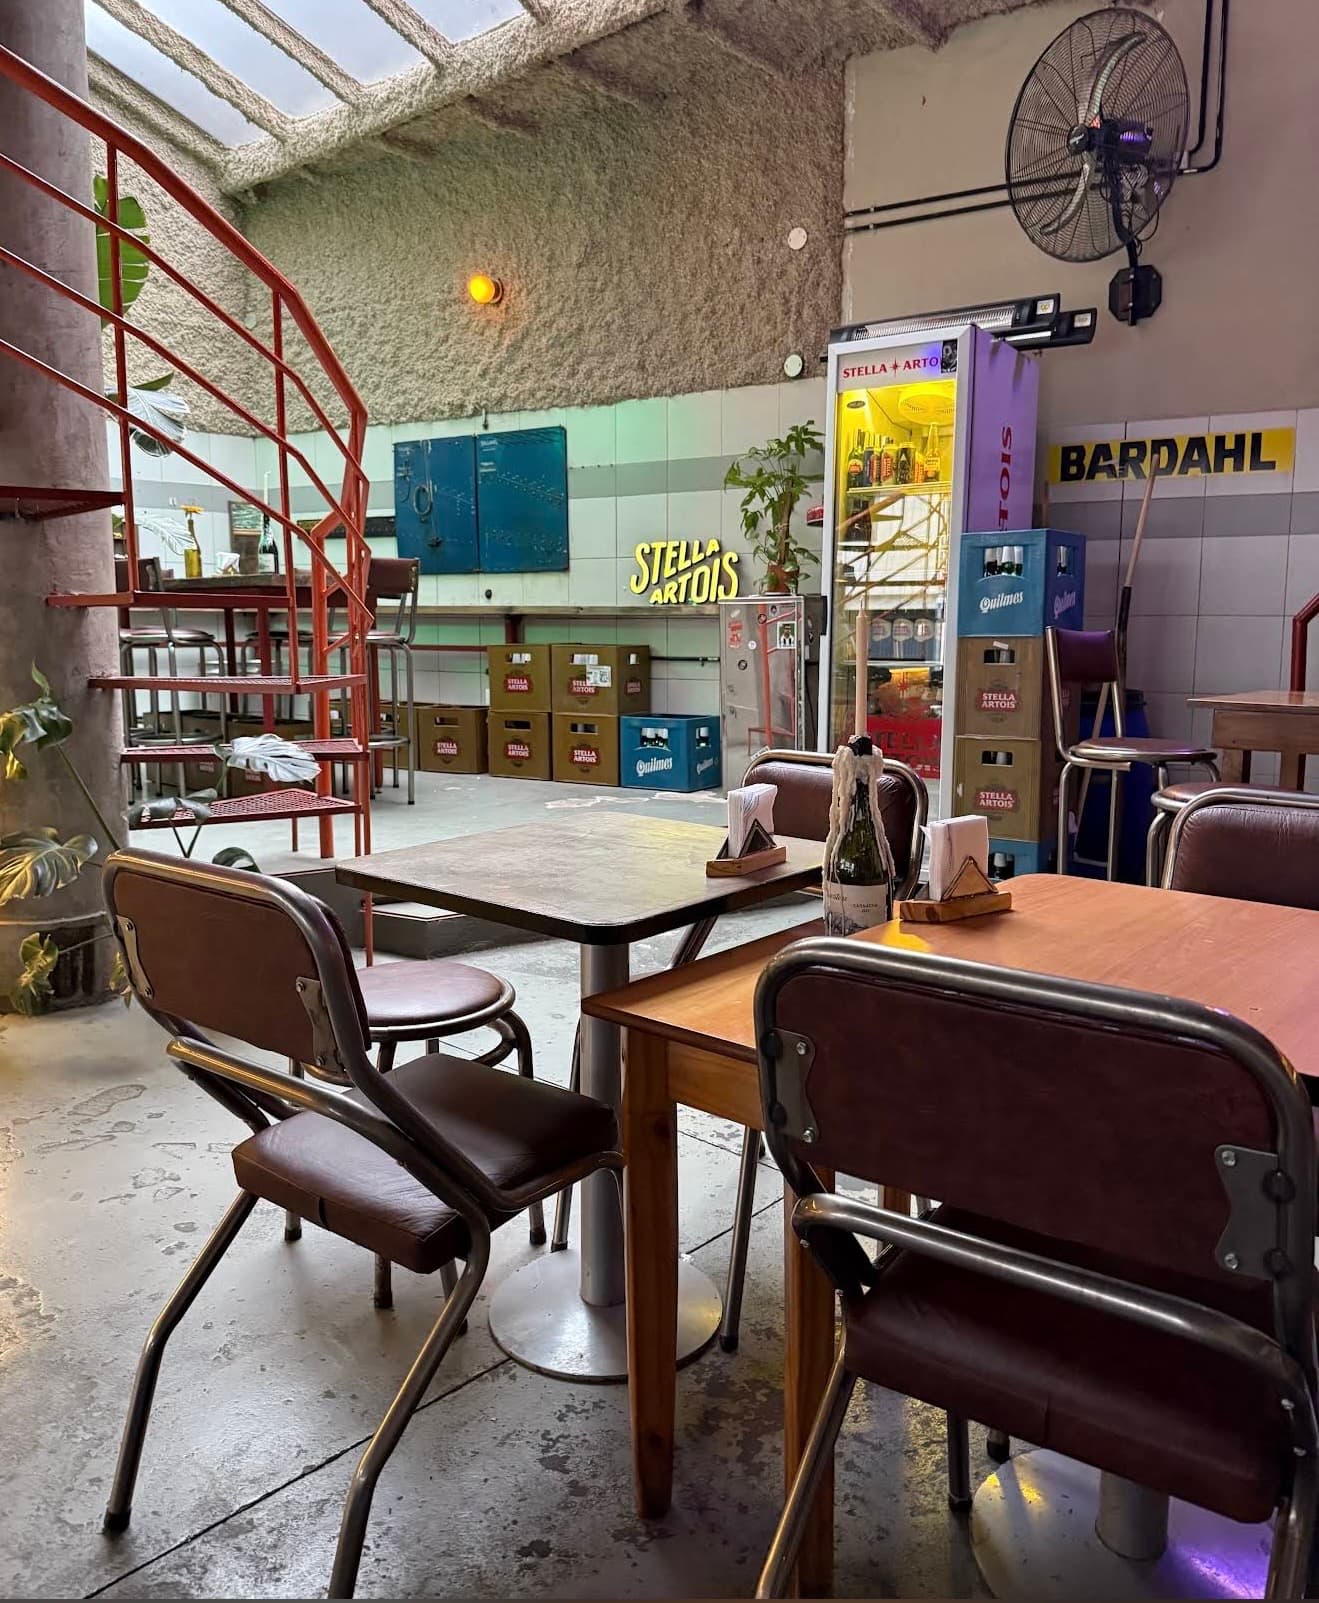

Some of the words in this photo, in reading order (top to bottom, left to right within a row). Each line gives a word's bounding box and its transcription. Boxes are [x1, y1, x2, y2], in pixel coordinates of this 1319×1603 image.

[843, 363, 887, 378] STELLA
[903, 356, 942, 370] ARTO
[1060, 432, 1276, 482] BARDAHL
[998, 426, 1012, 531] TOIS
[630, 538, 720, 594] STELLA
[649, 551, 739, 604] ARTOIS
[979, 590, 1024, 614] Quilmes
[981, 700, 1016, 709] ARTOIS
[982, 692, 1016, 701] STELLA
[635, 757, 673, 777] Quilmes
[979, 791, 1013, 800] STELLA
[979, 799, 1014, 809] ARTOIS
